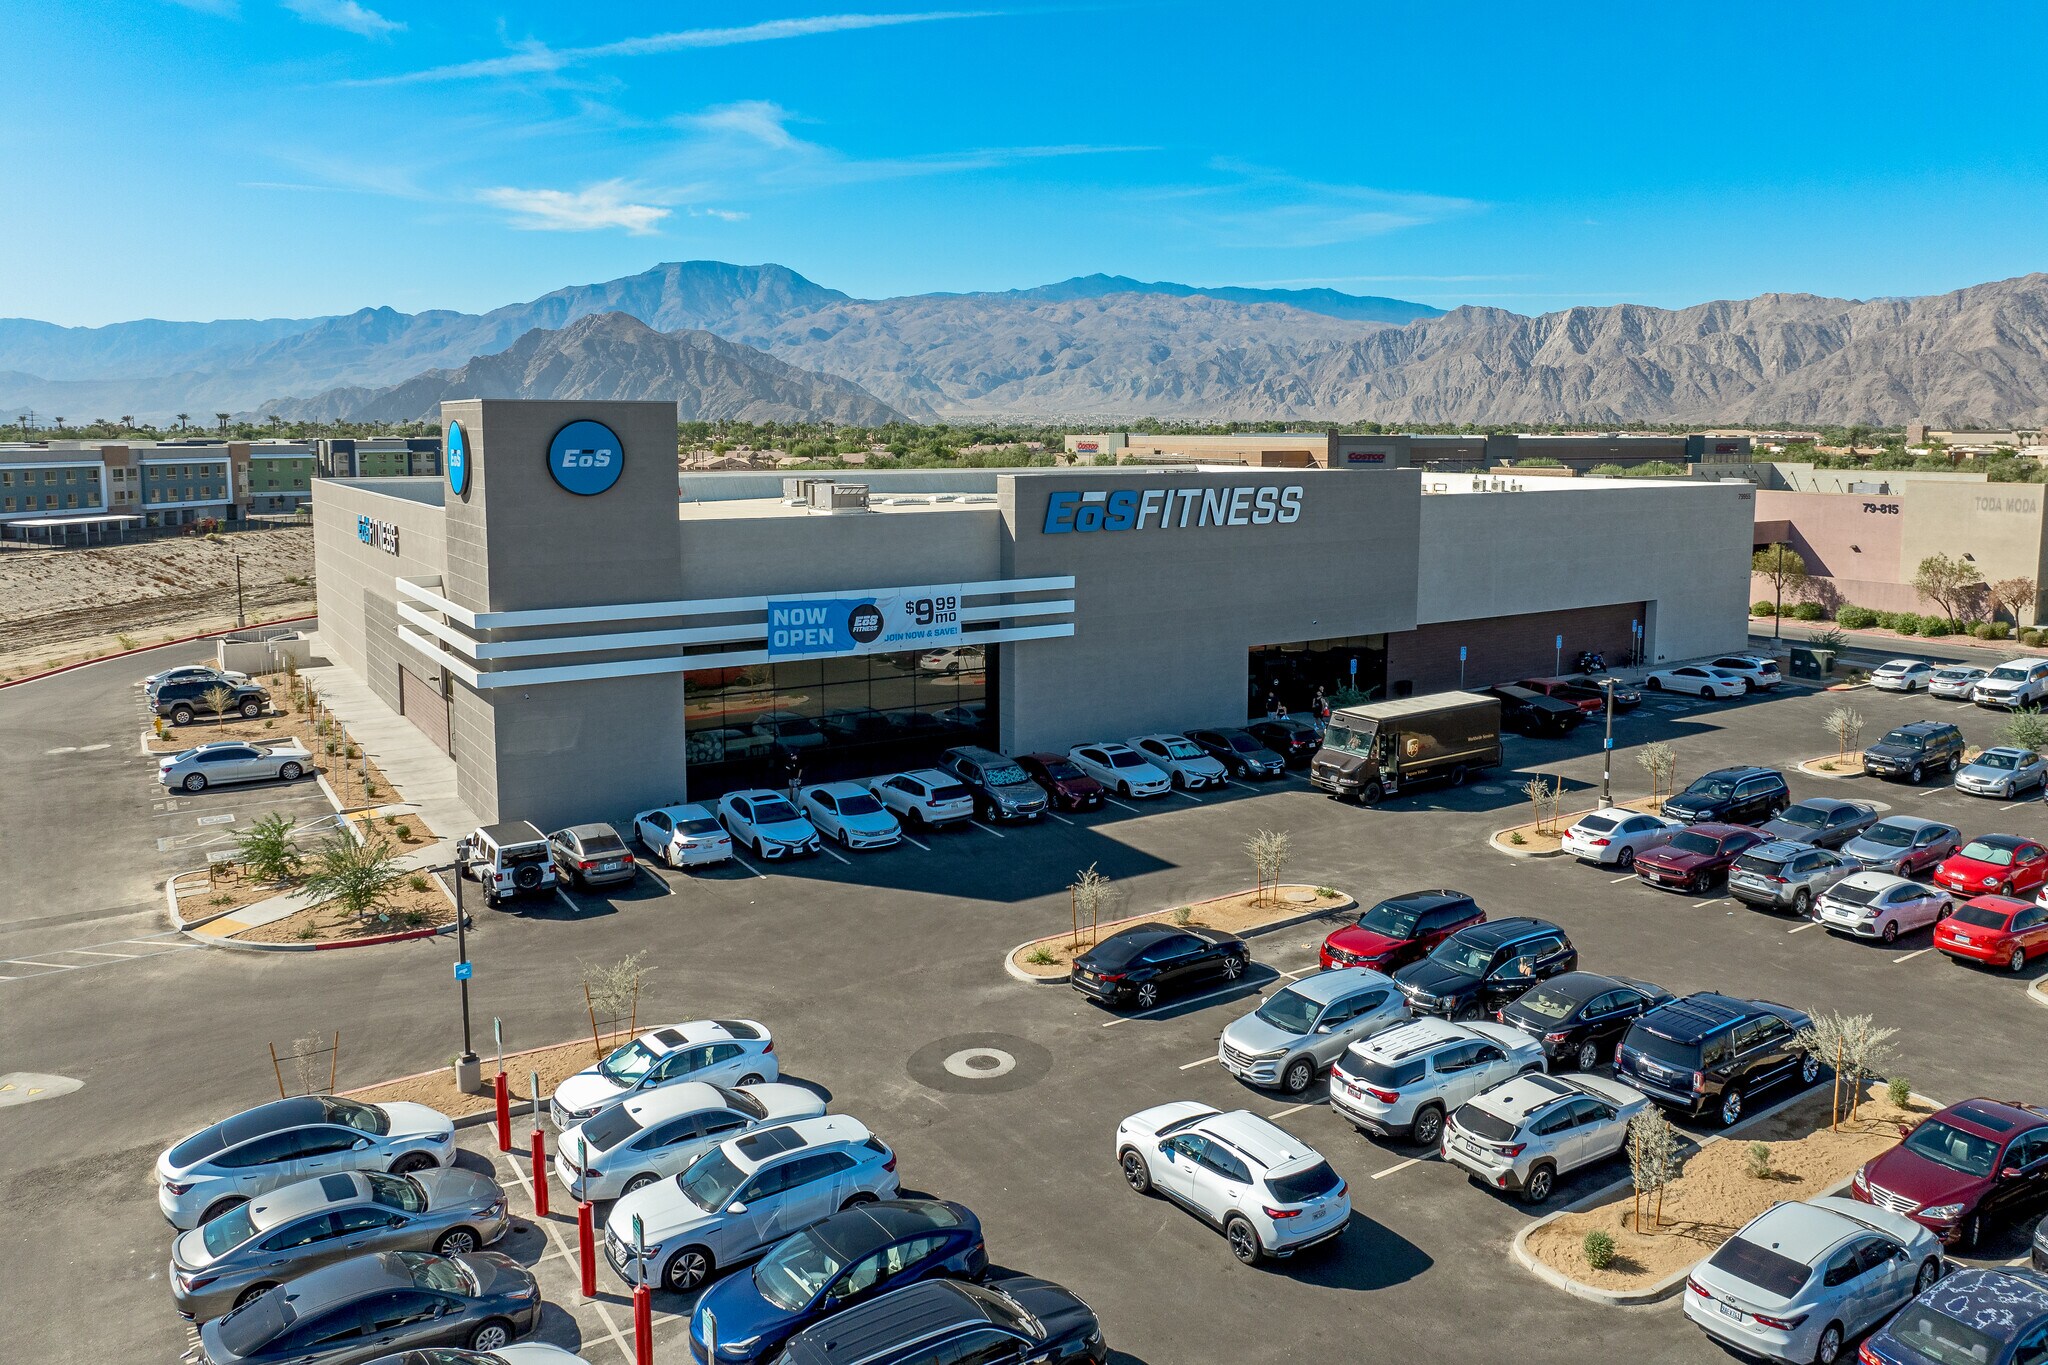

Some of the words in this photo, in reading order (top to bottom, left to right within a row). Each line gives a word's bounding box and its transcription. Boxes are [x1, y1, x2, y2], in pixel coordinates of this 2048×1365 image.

[1136, 486, 1304, 530] FITNESS
[1862, 502, 1899, 515] 79-815
[1976, 496, 2002, 512] TODA
[2005, 497, 2037, 514] MODA
[369, 518, 397, 554] FITNESS
[773, 607, 828, 627] NOW
[935, 612, 957, 624] mo
[773, 627, 834, 648] OPEN
[852, 625, 878, 633] FITNESS
[884, 633, 904, 642] JOIN
[905, 631, 925, 640] NOW
[926, 629, 933, 638] &
[934, 627, 958, 637] SAVE!
